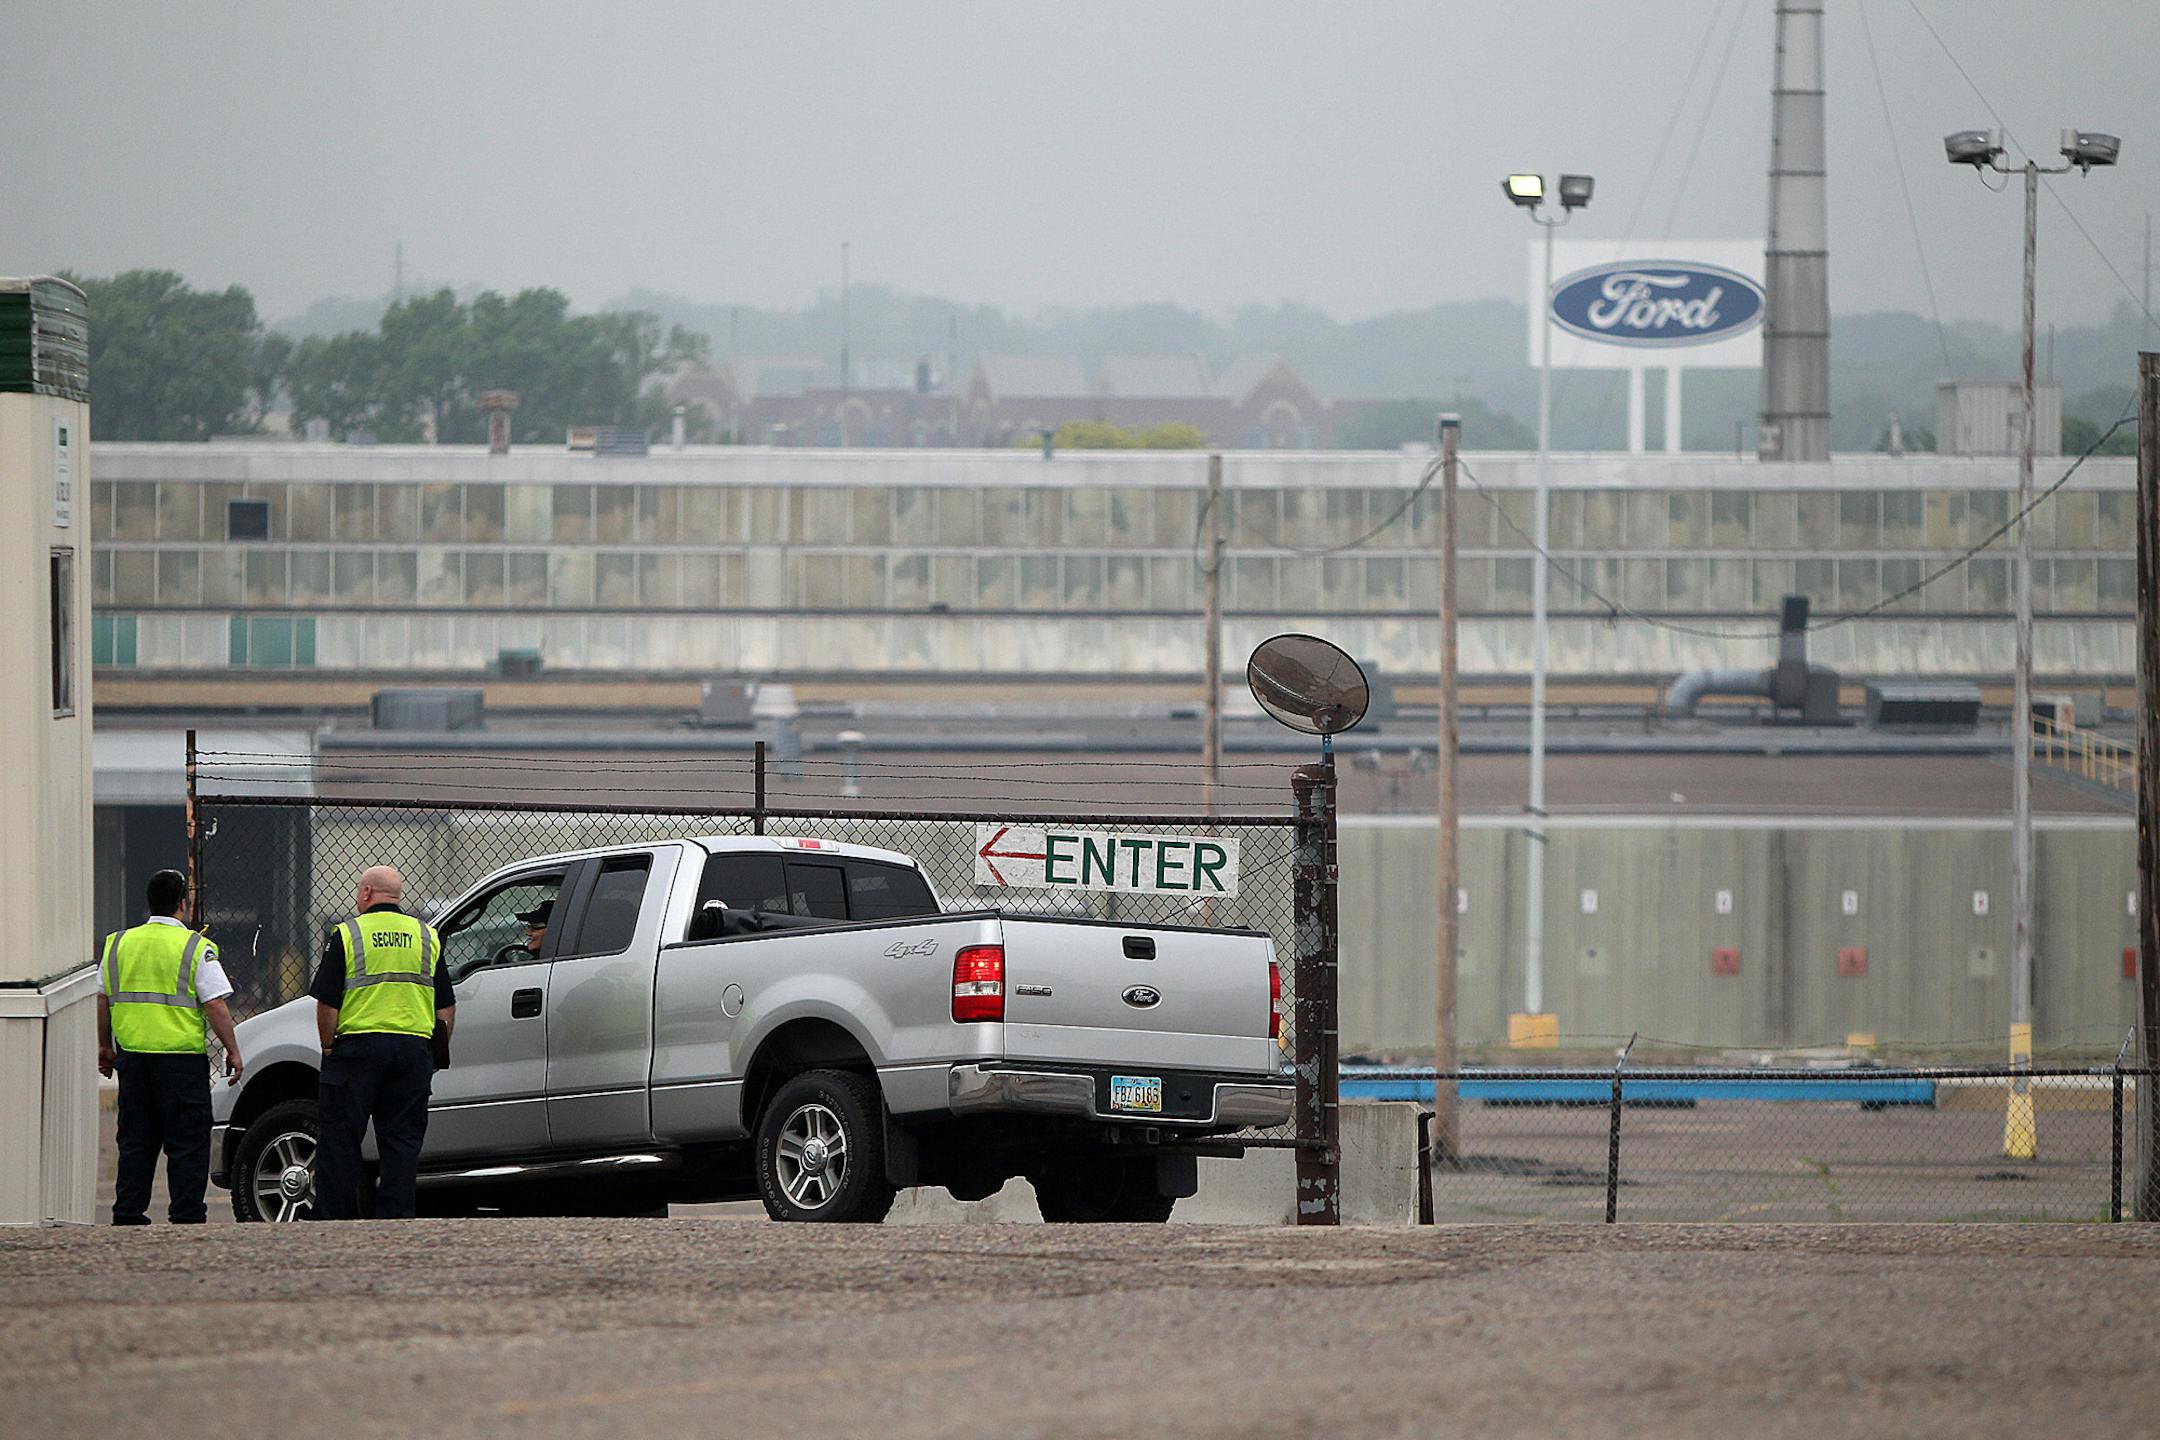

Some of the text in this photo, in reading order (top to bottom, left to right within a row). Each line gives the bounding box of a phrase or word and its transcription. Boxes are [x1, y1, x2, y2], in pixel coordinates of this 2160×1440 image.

[1588, 272, 1723, 329] Ford
[1045, 835, 1227, 892] ENTER
[372, 931, 413, 948] SECURITY
[884, 938, 939, 959] 4x4
